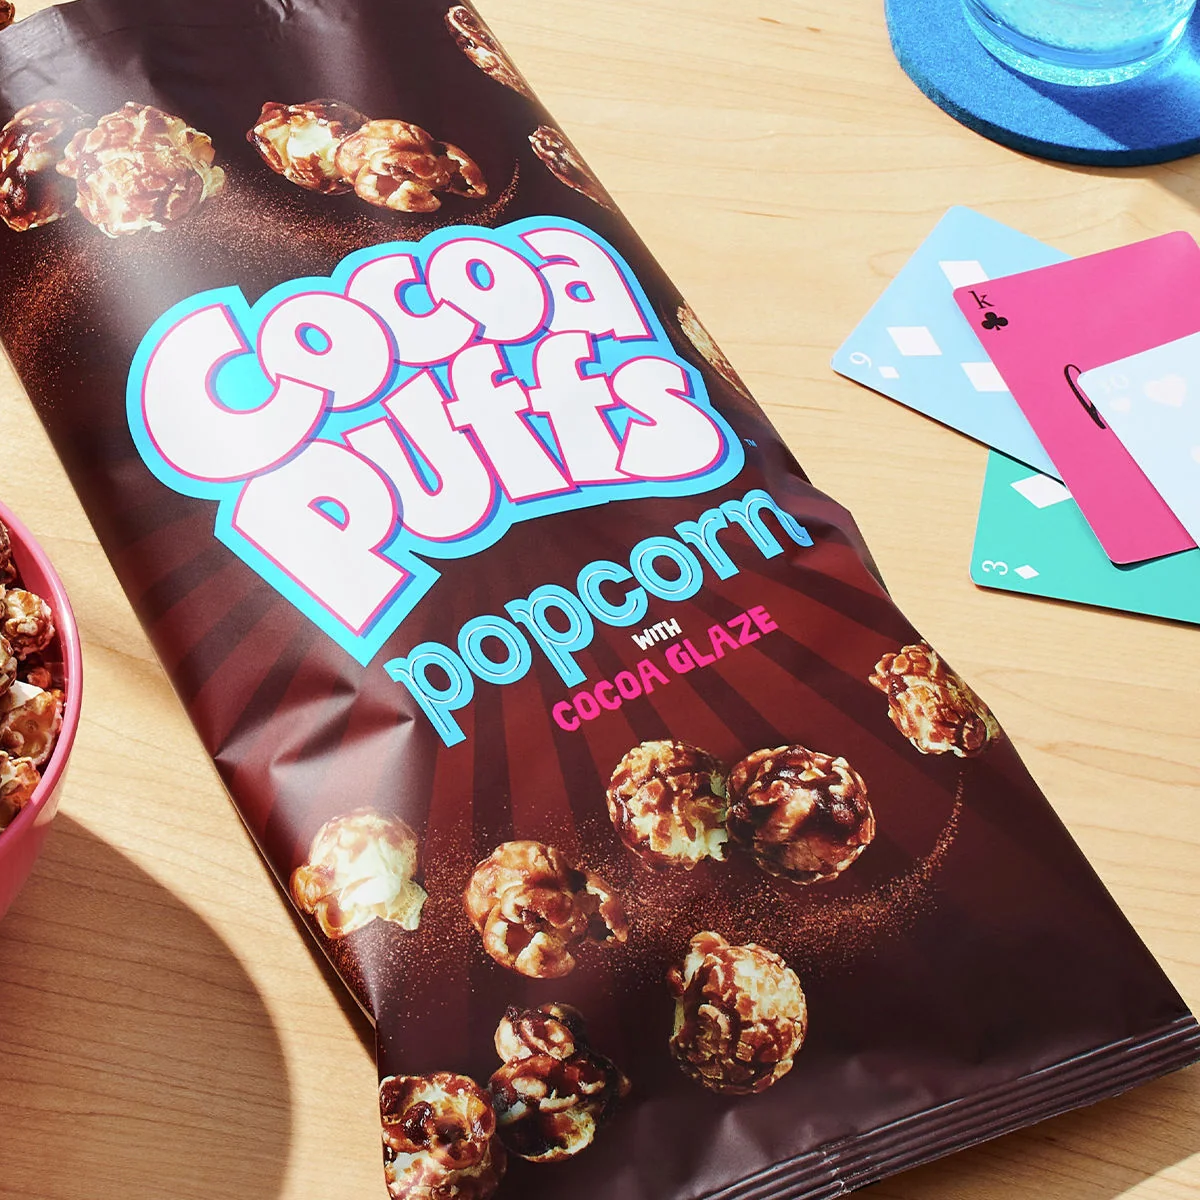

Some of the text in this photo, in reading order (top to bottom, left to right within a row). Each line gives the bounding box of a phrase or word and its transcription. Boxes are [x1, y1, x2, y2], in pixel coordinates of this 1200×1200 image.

[140, 226, 657, 483] Cocoa
[968, 290, 995, 309] k
[231, 330, 726, 638] Puffs
[384, 488, 813, 748] popcorn
[981, 559, 1008, 576] 3
[552, 605, 779, 732] COCOA GLAZE
[631, 617, 683, 651] WITH
